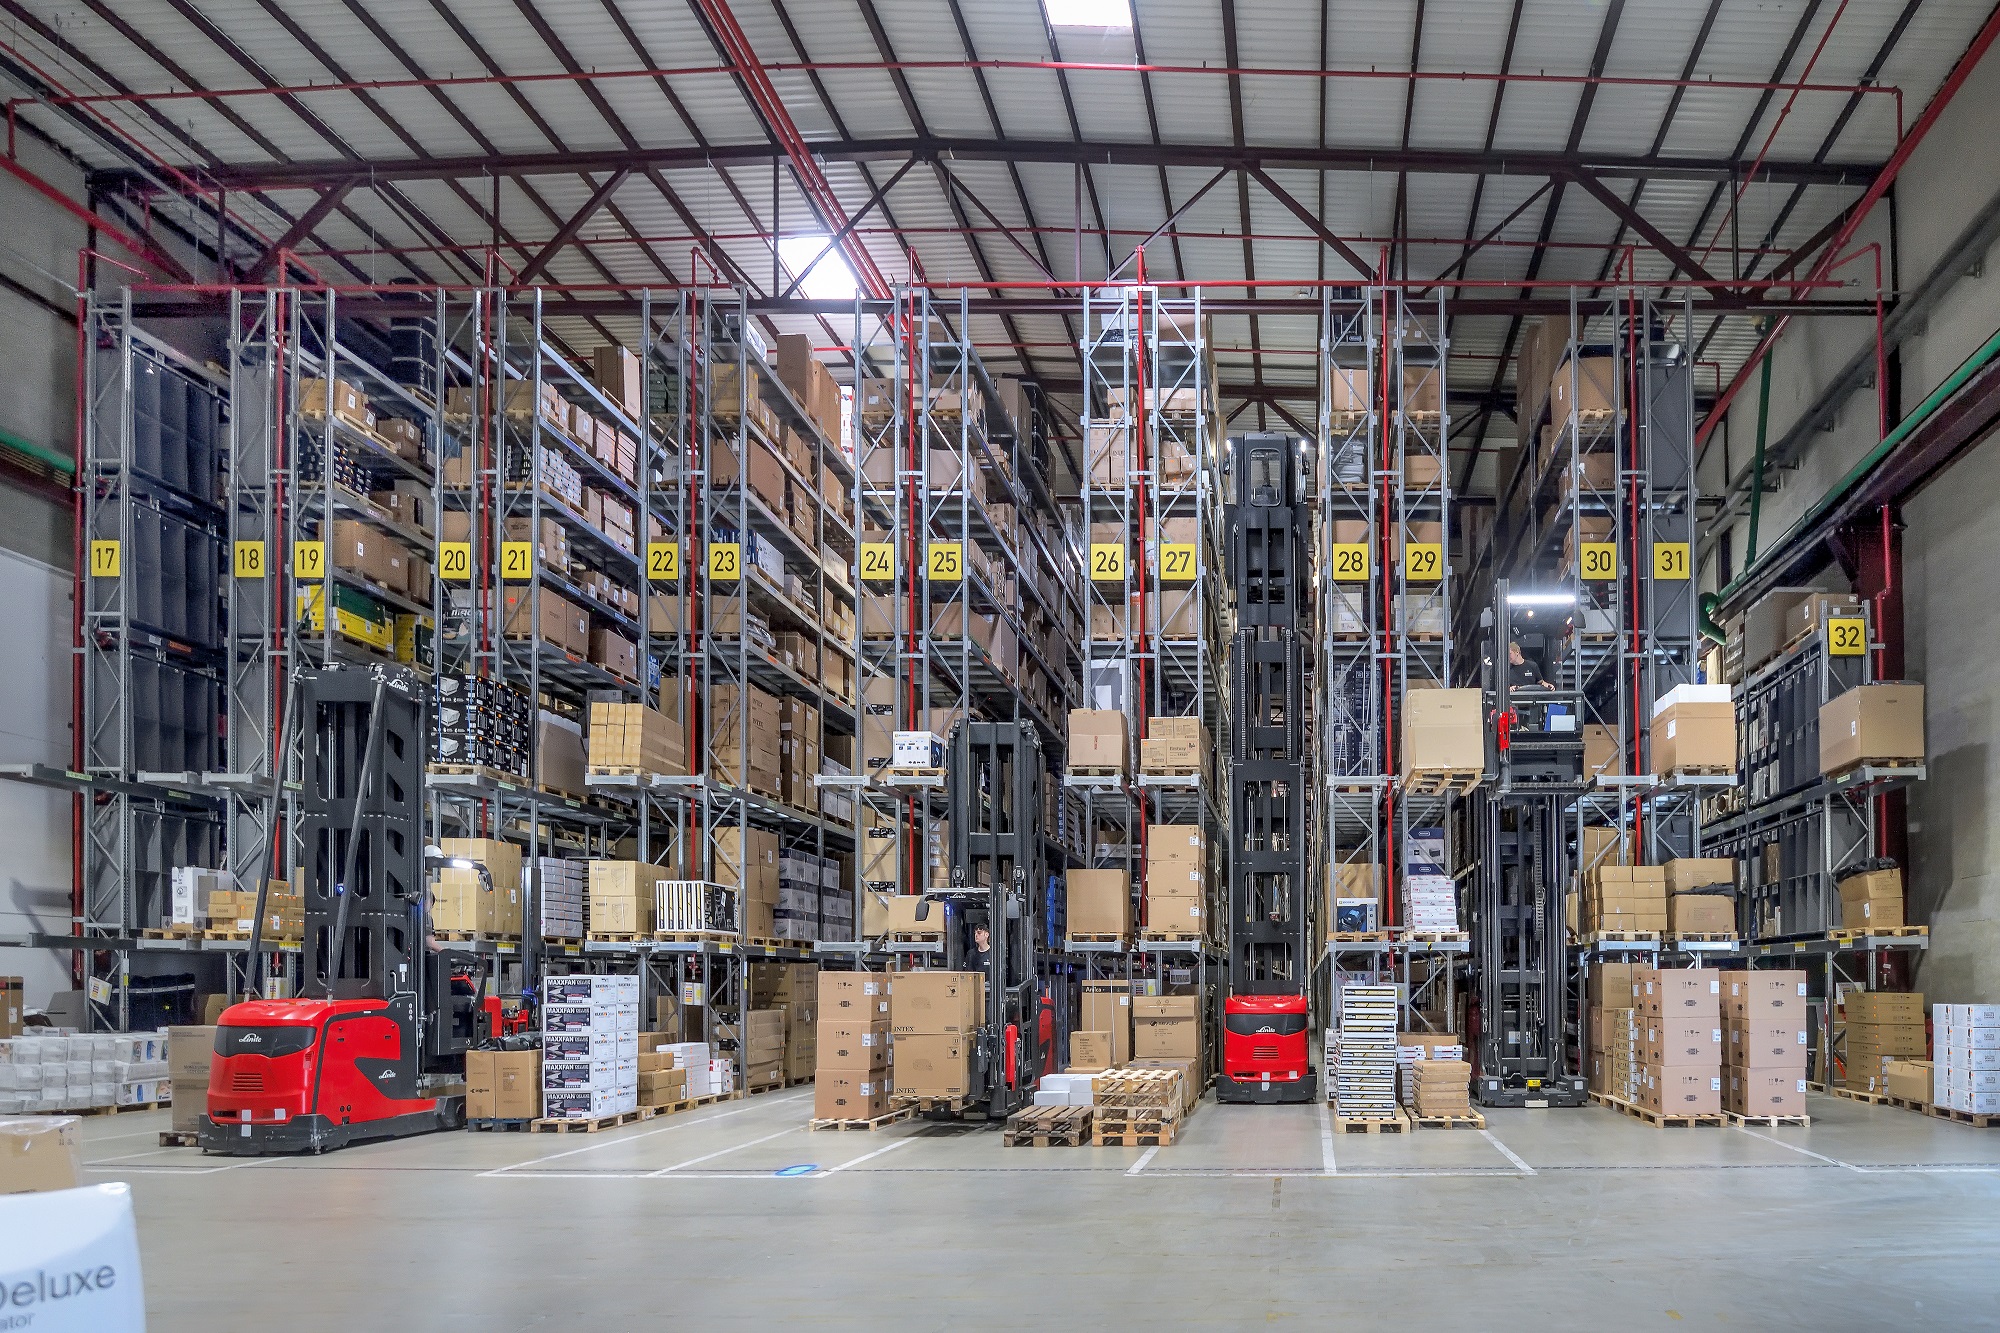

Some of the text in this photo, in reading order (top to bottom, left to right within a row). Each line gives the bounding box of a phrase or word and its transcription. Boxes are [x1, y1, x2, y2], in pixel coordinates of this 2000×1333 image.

[96, 548, 114, 569] 17
[240, 549, 258, 569] 18
[299, 549, 319, 570] 19
[445, 550, 466, 571] 20
[508, 550, 526, 571] 21
[652, 551, 674, 571] 22
[714, 551, 735, 571] 23
[865, 551, 889, 572] 24
[934, 551, 957, 572] 25
[1095, 551, 1120, 572] 26
[1165, 551, 1191, 572] 27
[1338, 551, 1363, 572] 28
[1411, 551, 1436, 572] 29
[1586, 551, 1611, 571] 30
[1661, 551, 1683, 571] 31
[1834, 626, 1860, 647] 32
[386, 678, 409, 693] Linde
[238, 1033, 262, 1043] Linde
[1255, 1025, 1276, 1033] Linde
[378, 1069, 397, 1079] Linde
